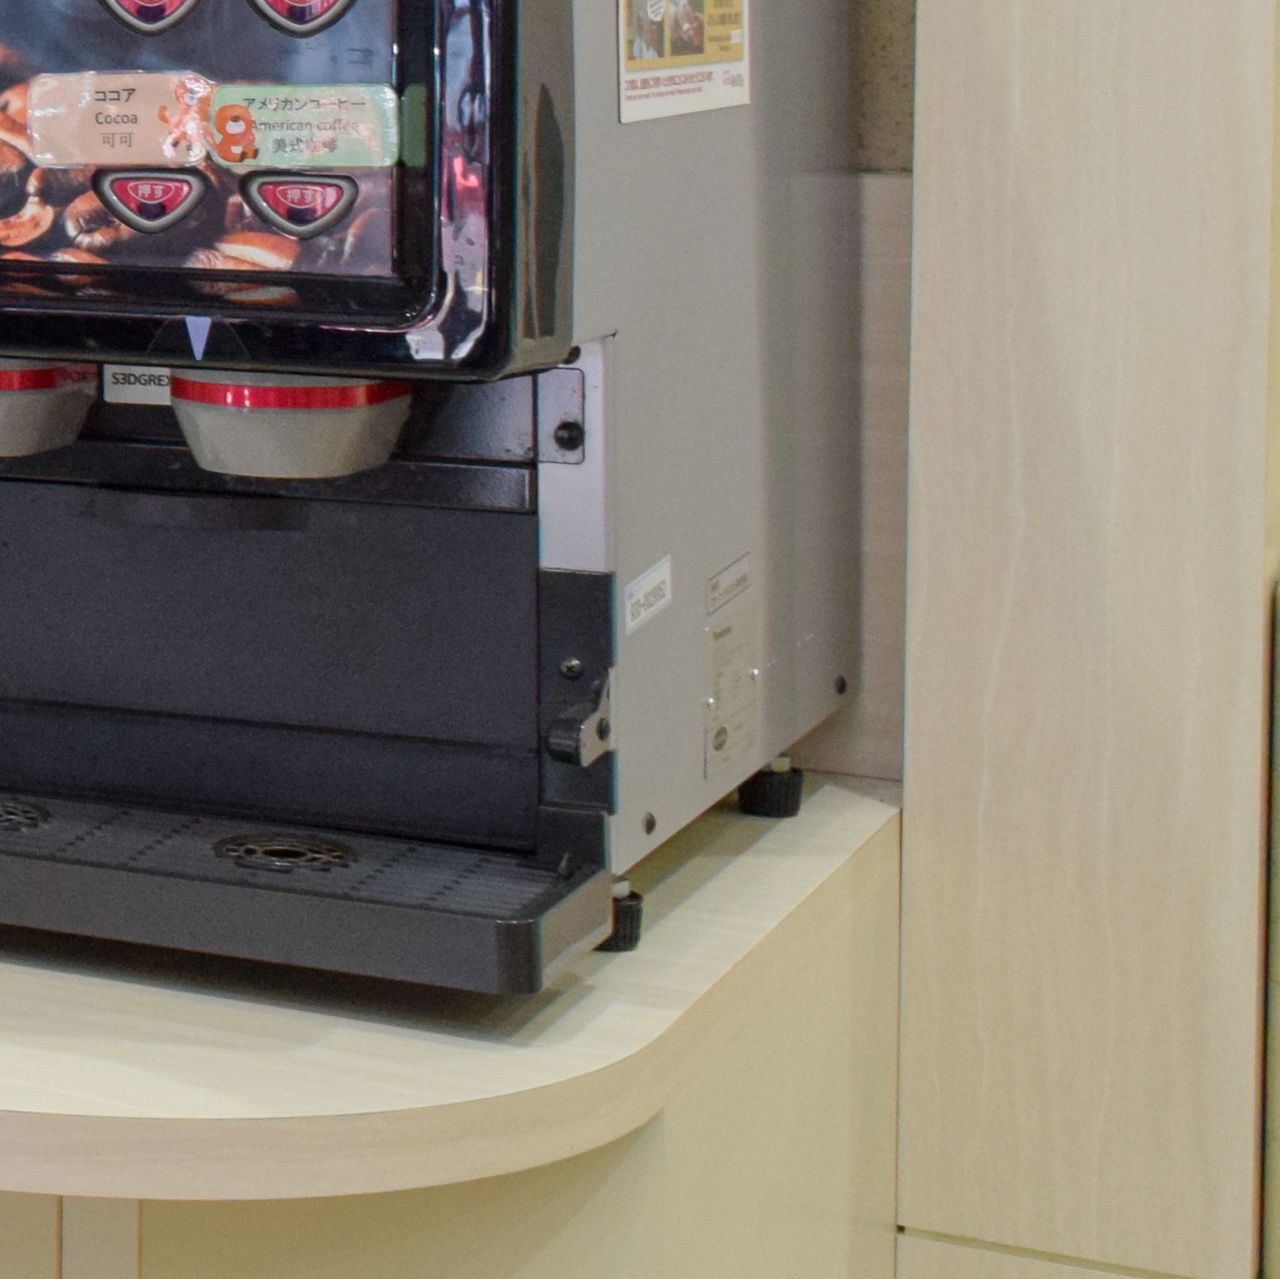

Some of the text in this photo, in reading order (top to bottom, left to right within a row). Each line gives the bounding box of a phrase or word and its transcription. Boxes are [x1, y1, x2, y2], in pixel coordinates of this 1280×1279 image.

[94, 88, 137, 102] ココア
[242, 97, 366, 111] アメリカンコーヒー
[95, 112, 138, 125] Cocoa
[252, 119, 359, 132] American coffee
[102, 132, 134, 148] 可可
[138, 184, 165, 198] 押す
